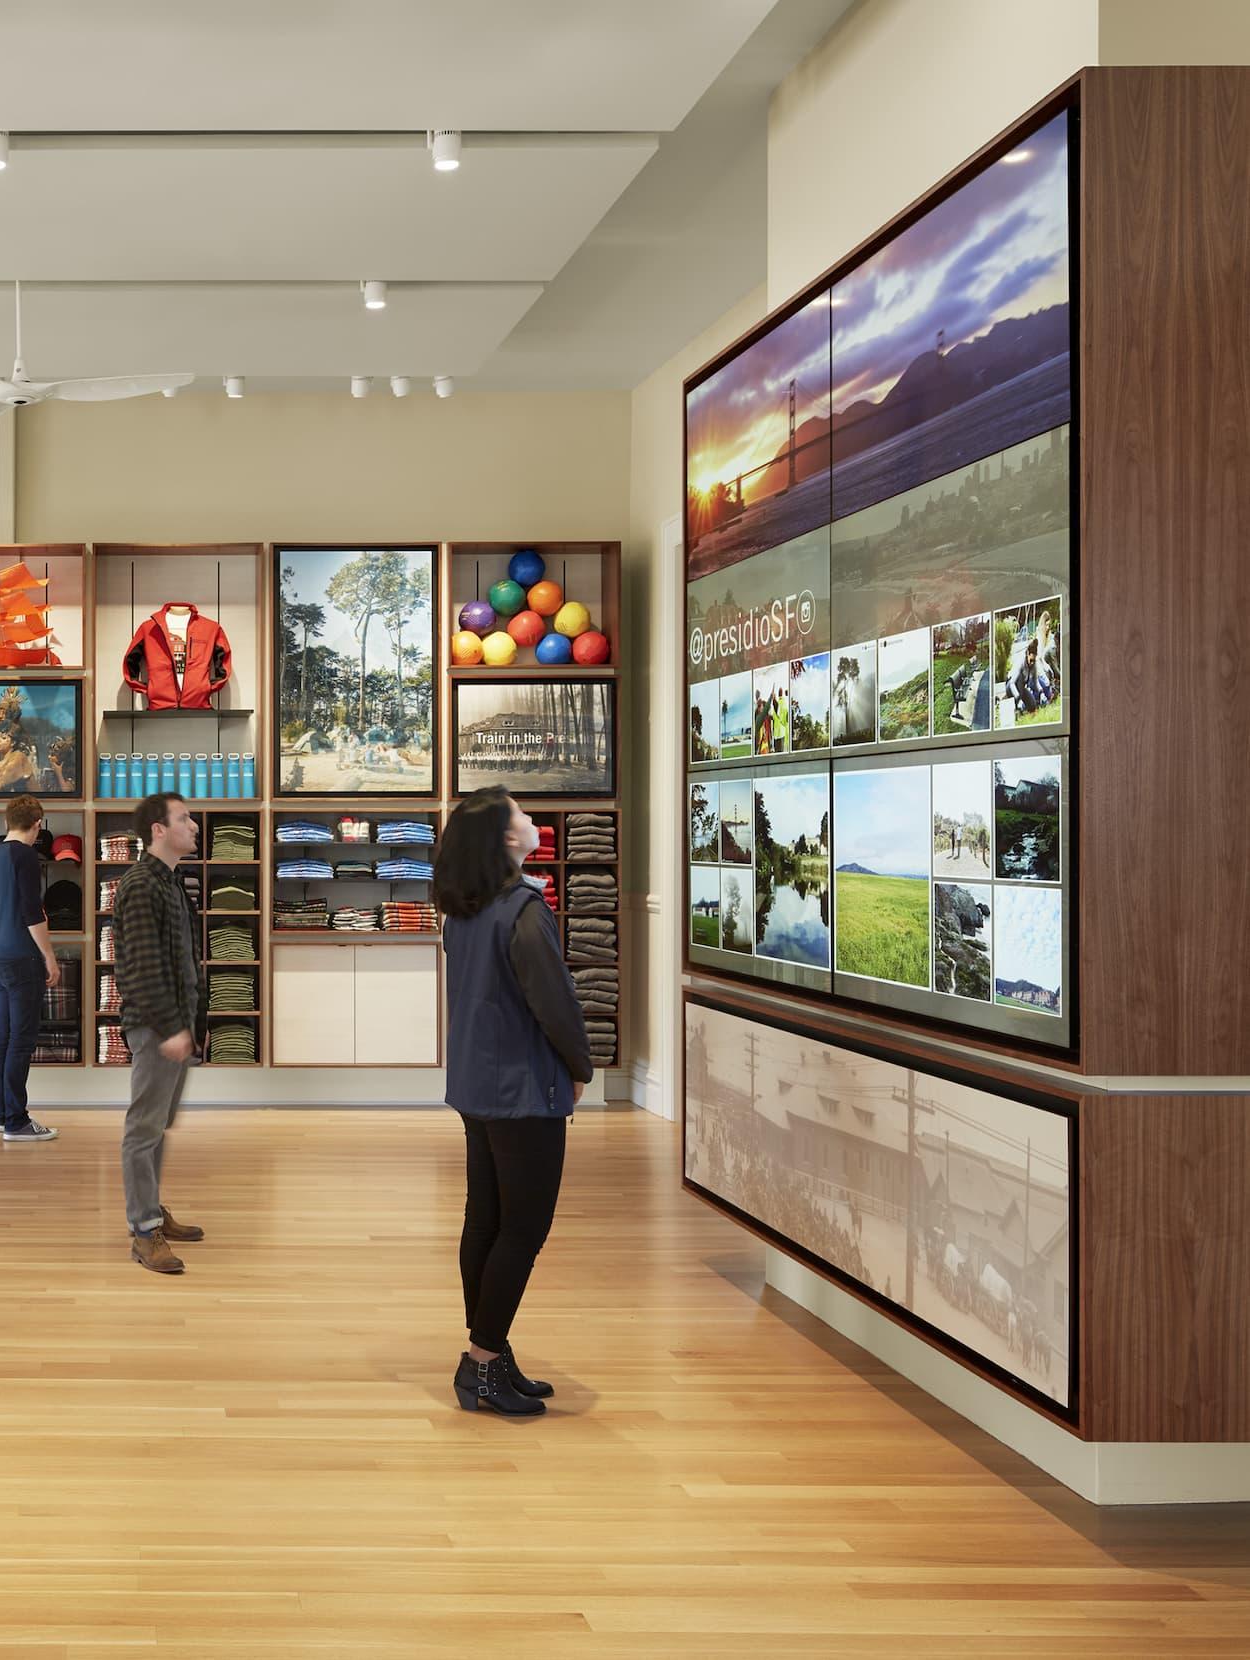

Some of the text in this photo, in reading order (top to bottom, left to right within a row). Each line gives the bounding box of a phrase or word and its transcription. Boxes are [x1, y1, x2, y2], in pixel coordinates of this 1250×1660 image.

[690, 594, 797, 671] @presidioSF
[476, 732, 505, 744] Train
[510, 732, 520, 744] in
[524, 732, 542, 744] the
